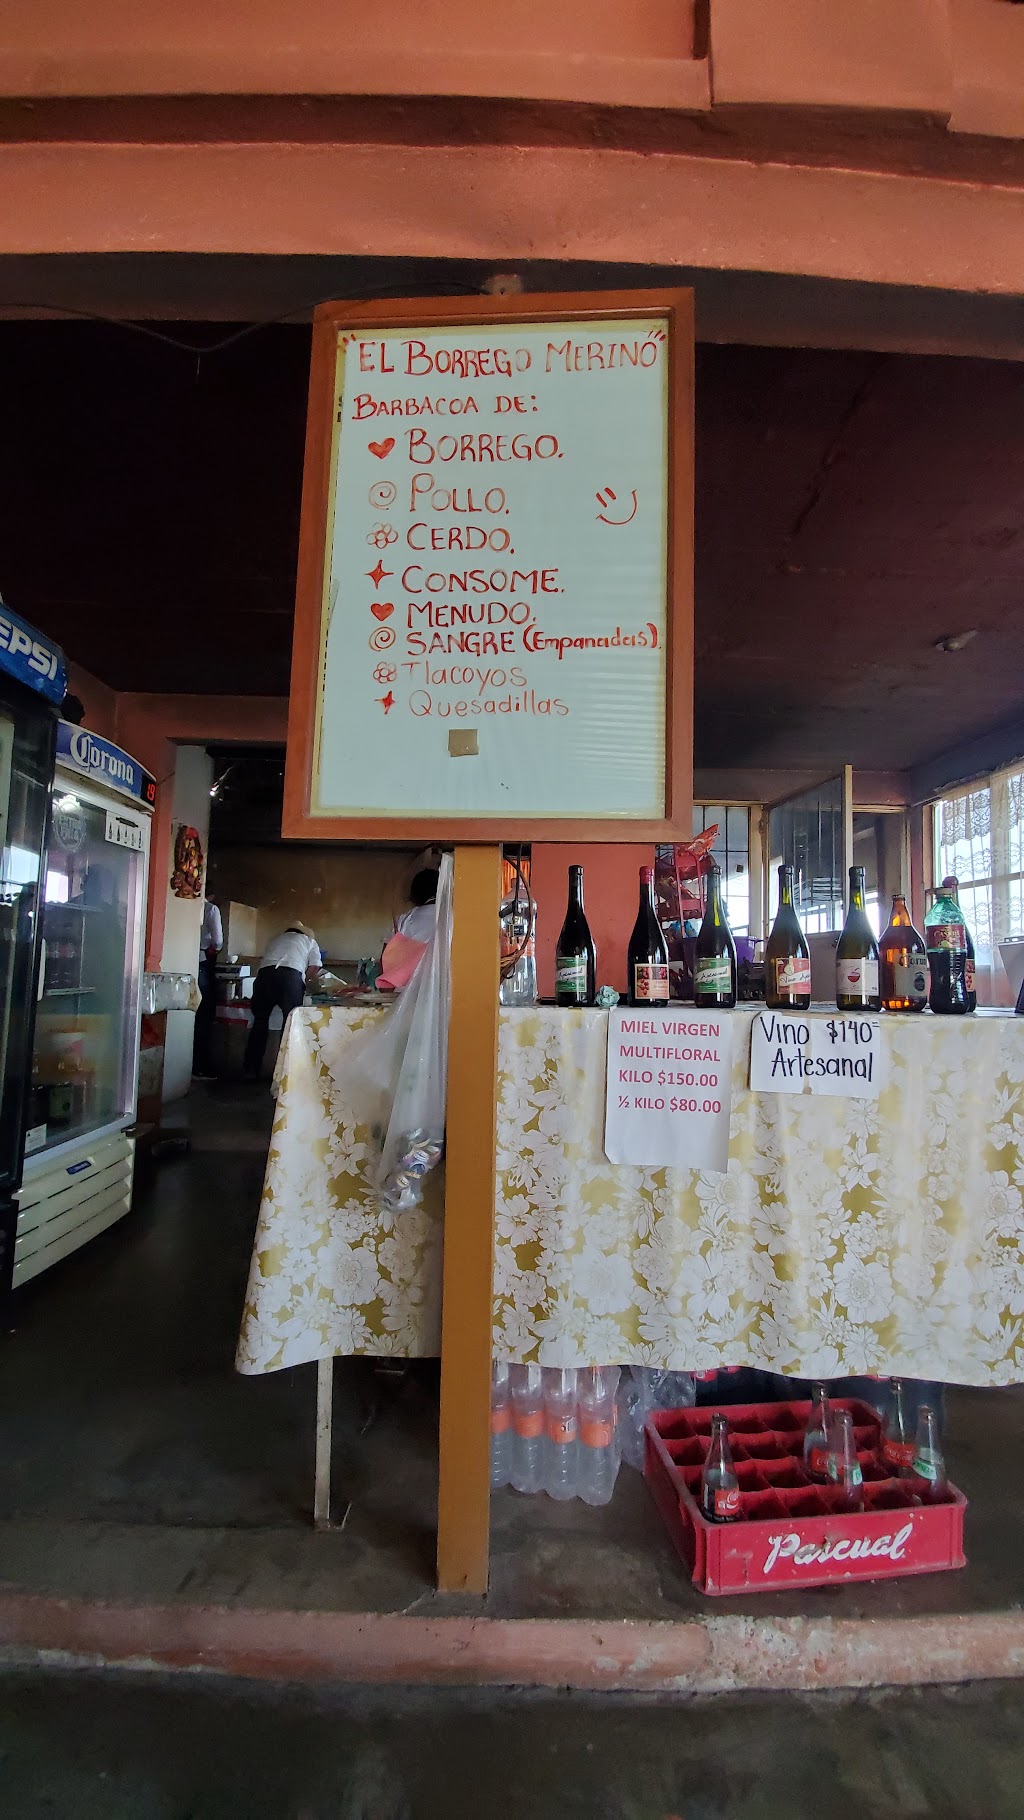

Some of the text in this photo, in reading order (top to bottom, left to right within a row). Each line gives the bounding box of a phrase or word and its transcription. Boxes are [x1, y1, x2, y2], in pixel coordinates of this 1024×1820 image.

[403, 340, 532, 378] BORREGO
[352, 394, 539, 420] BARBACOA DE:
[405, 428, 565, 464] BORREGO.
[409, 473, 511, 516] POLLO.
[407, 523, 516, 554] CERDO.
[402, 565, 566, 594] CONSOME.
[407, 601, 538, 629] MENUDO.
[406, 630, 516, 656] SANGRE
[402, 661, 528, 696] Tlacoyos
[409, 689, 569, 718] Quesadillas
[70, 730, 135, 786] Corona
[620, 1020, 720, 1037] MIEL VIRGEN
[759, 1015, 810, 1045] Vino
[619, 1045, 721, 1062] MULTIFLORAL
[771, 1047, 874, 1082] Artesanal
[619, 1070, 719, 1088] KILO $150.00
[634, 1097, 665, 1110] KILO
[669, 1098, 721, 1114] $80.00
[763, 1522, 913, 1574] Pascual
